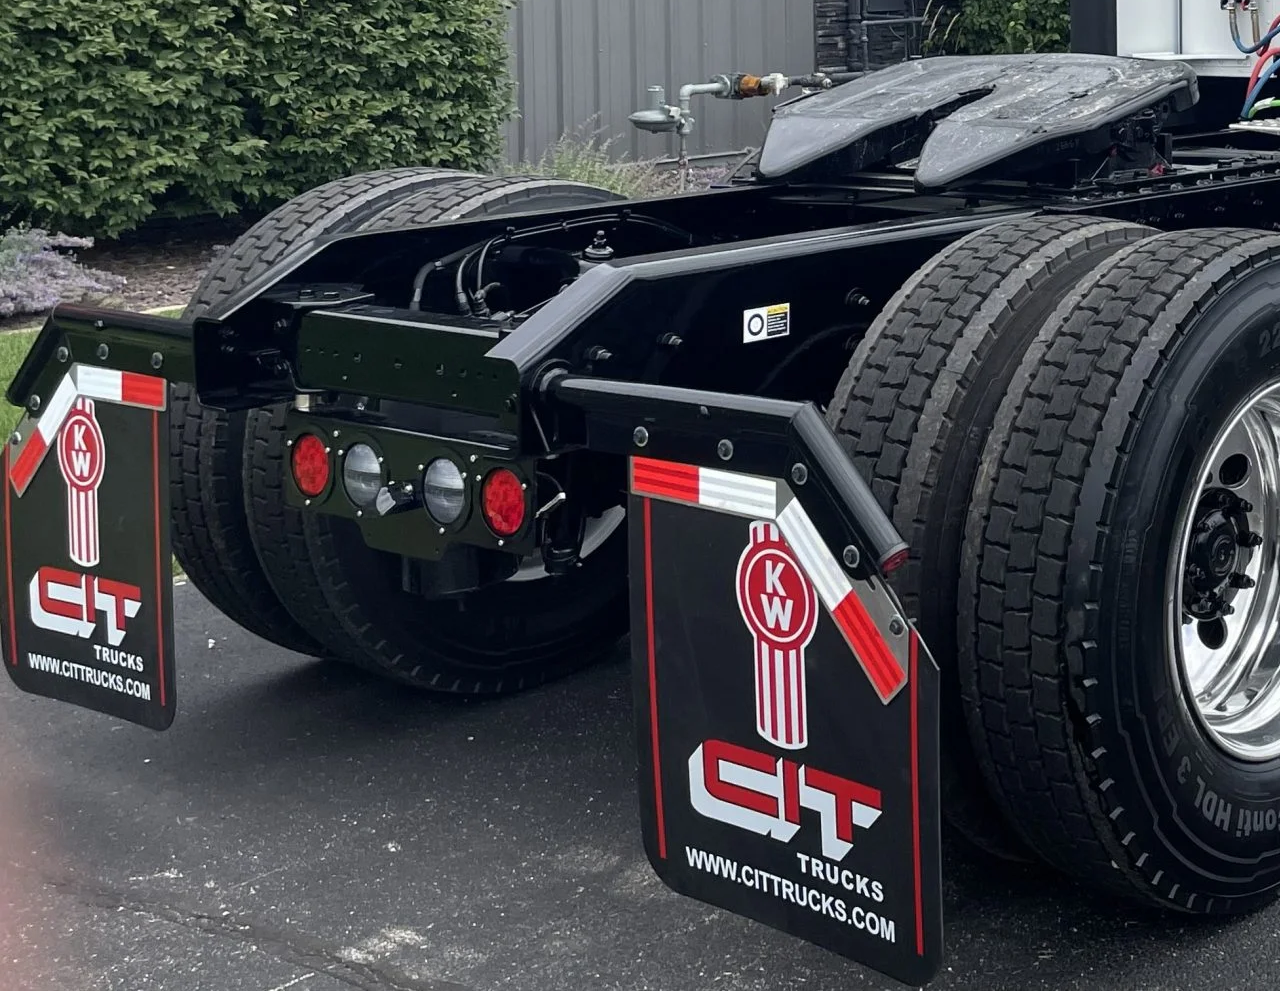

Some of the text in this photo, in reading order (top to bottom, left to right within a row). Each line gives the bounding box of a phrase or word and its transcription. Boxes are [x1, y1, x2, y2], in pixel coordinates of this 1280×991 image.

[30, 567, 142, 646] CIT
[28, 651, 152, 702] WWW.CITTRUCKS.COM
[94, 645, 145, 673] TRUCKS
[1176, 755, 1192, 785] 3
[688, 738, 883, 863] CIT
[1192, 774, 1233, 833] HDL
[685, 845, 896, 943] WWW.CITTRUCKS.COM
[796, 851, 885, 903] TRUCKS
